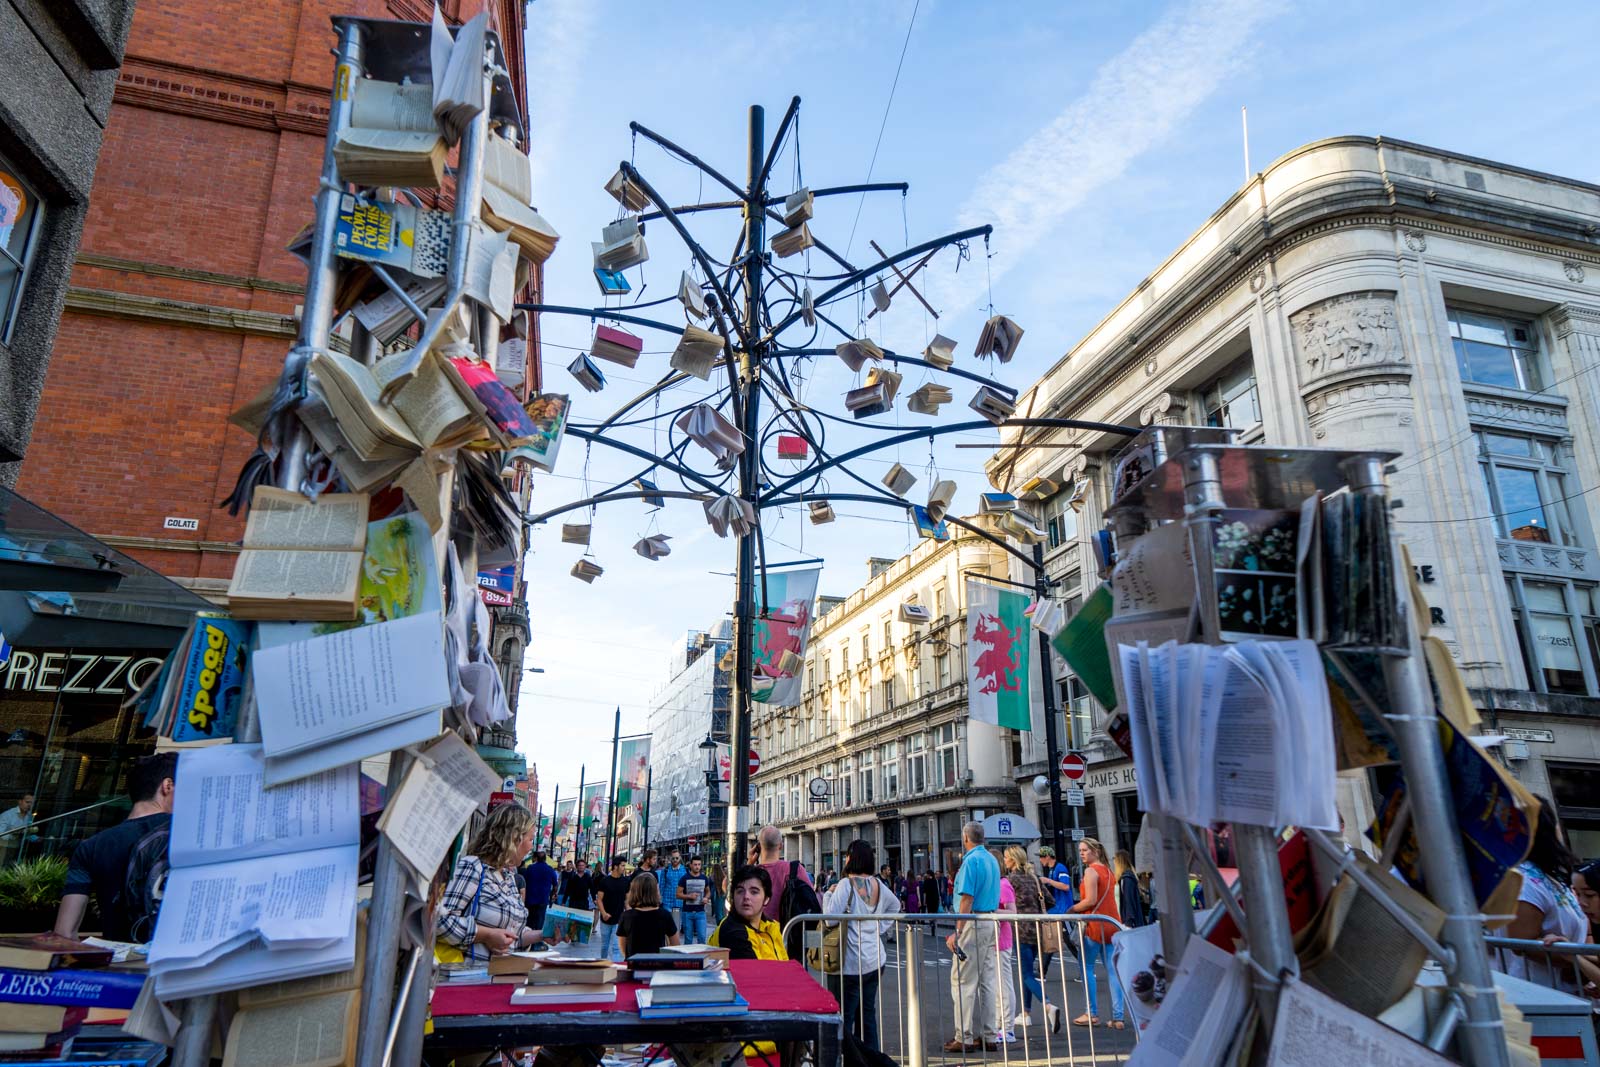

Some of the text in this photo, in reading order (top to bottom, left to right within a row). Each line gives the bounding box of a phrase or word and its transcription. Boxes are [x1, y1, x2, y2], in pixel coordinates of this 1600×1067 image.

[364, 204, 380, 249] FOR HIS
[376, 212, 392, 251] PRAISE
[1550, 636, 1572, 647] zest
[190, 650, 201, 681] LEARN
[186, 680, 195, 699] AND
[1089, 771, 1119, 788] JAMES
[54, 979, 104, 993] Antiques
